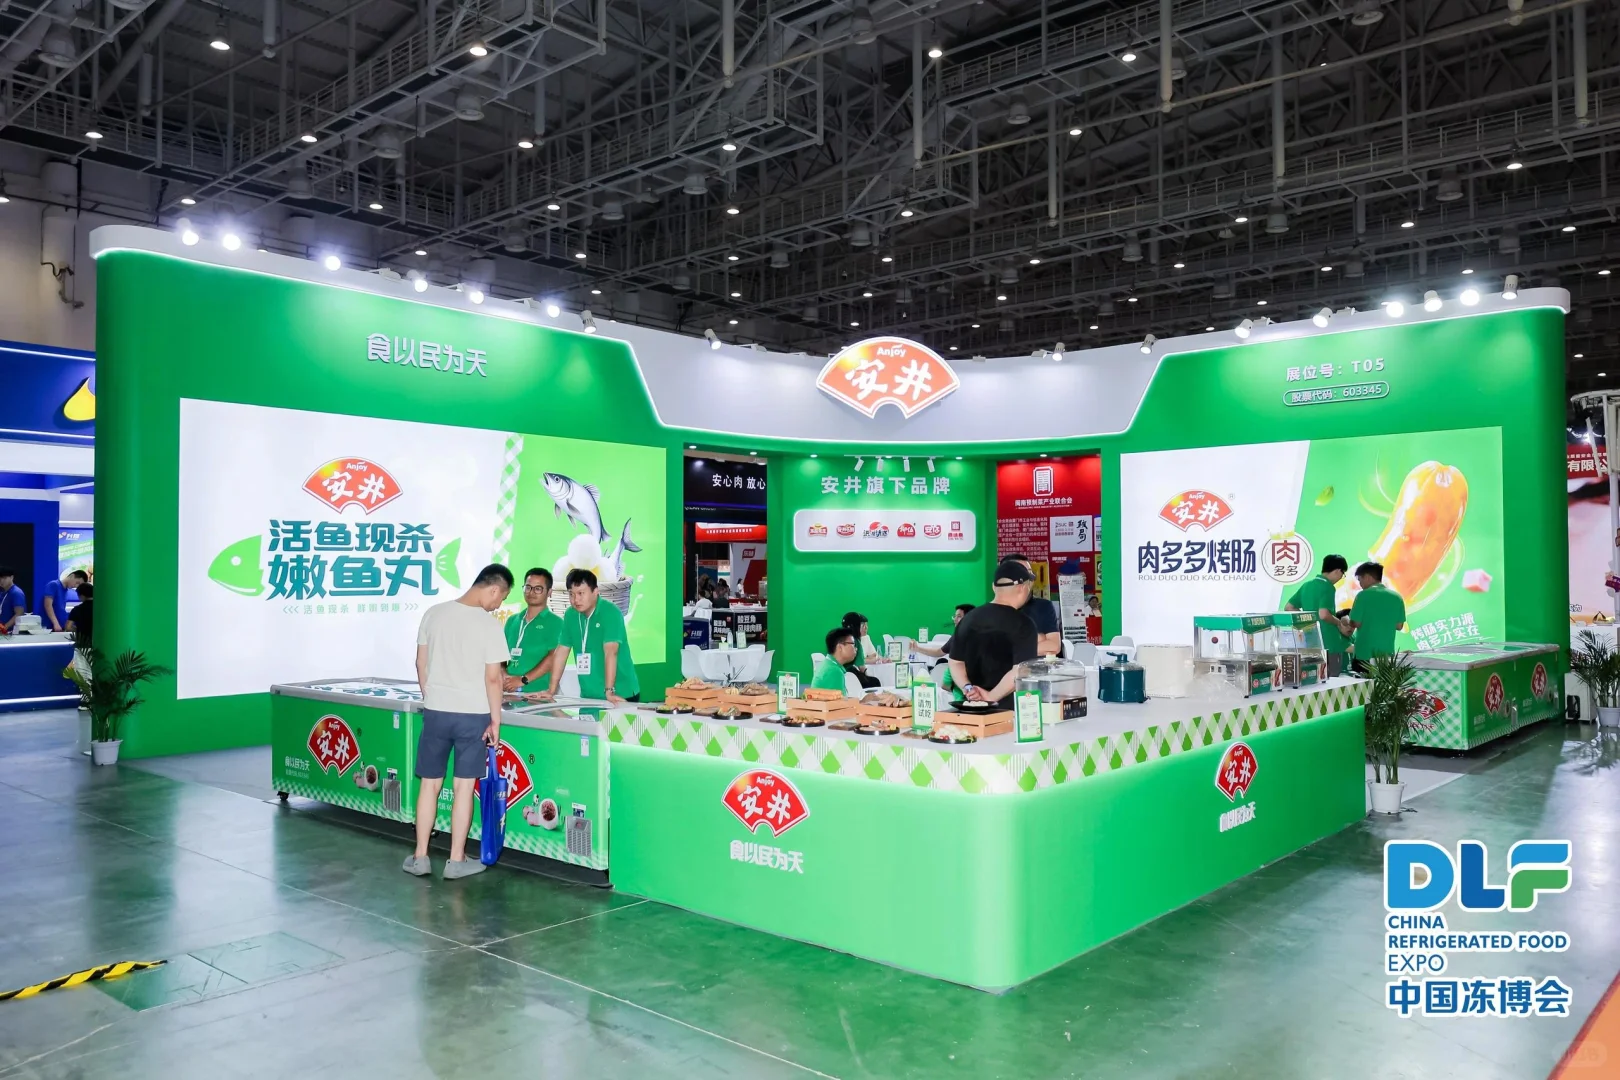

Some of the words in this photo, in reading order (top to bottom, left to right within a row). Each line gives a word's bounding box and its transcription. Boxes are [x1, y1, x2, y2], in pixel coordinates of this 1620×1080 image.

[366, 332, 487, 377] 食以民为天
[877, 344, 906, 357] Anjoy
[844, 359, 932, 401] 安井
[346, 461, 368, 472] Anjoy
[322, 471, 386, 504] 安井
[712, 474, 742, 489] 安心肉
[746, 477, 766, 490] 放心
[821, 476, 950, 495] 安井旗下品牌
[1188, 491, 1205, 500] Anjoy
[1172, 500, 1220, 524] 安井
[267, 519, 434, 553] 活鱼现杀
[1138, 539, 1257, 574] 肉多多烤肠
[1271, 540, 1301, 565] 肉
[266, 554, 439, 601] 嫩鱼丸
[1273, 565, 1299, 577] 多多
[303, 603, 350, 615] 活鱼现杀
[1411, 612, 1475, 641] 烤肠实力派
[1416, 624, 1481, 651] 肉多才实在
[918, 699, 932, 709] 请勿
[918, 709, 932, 718] 试吃
[317, 730, 350, 765] 安井
[1225, 756, 1251, 791] 安井
[737, 785, 791, 825] 安井
[729, 839, 804, 874] 食以民为天
